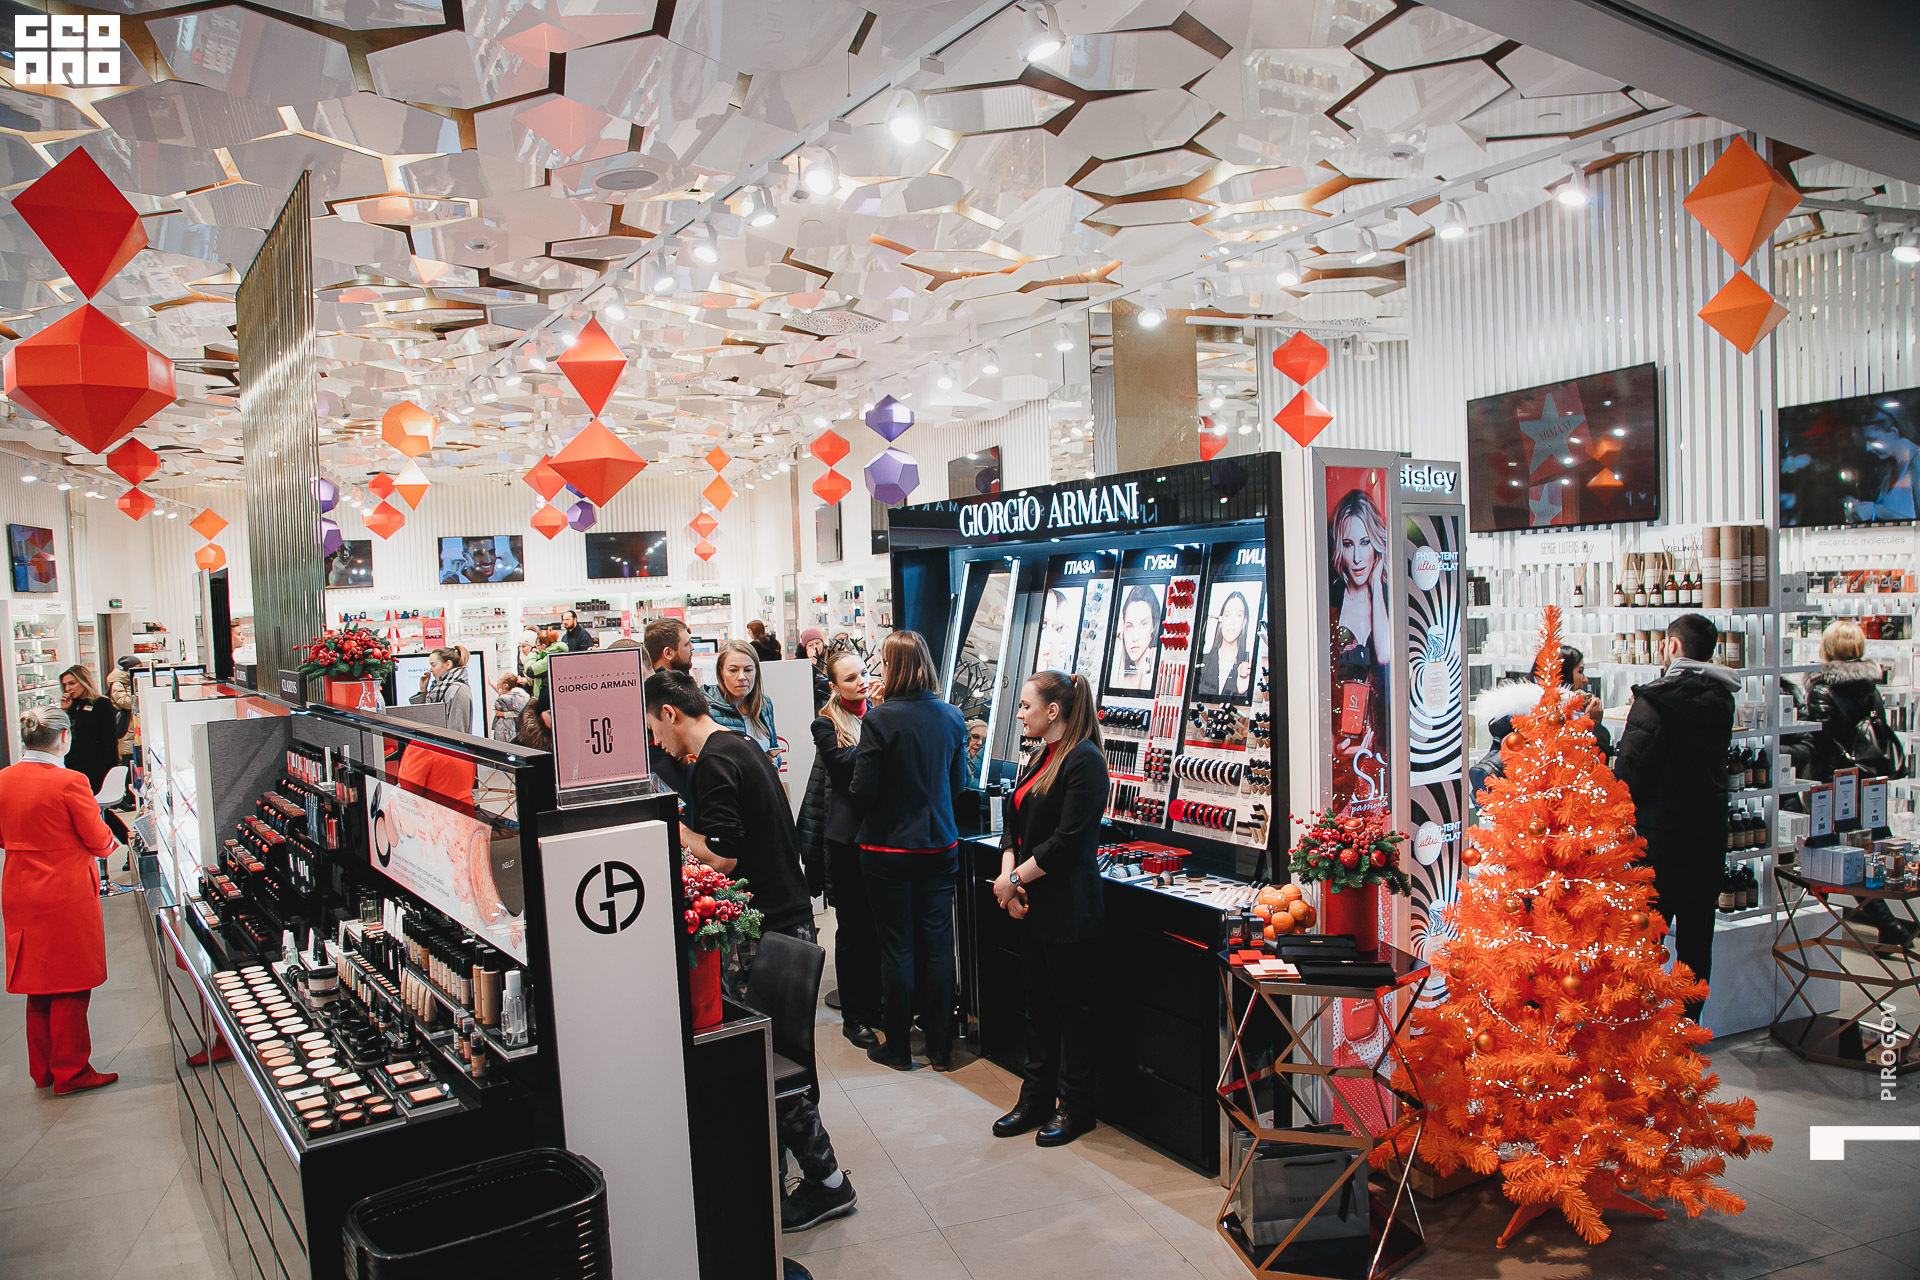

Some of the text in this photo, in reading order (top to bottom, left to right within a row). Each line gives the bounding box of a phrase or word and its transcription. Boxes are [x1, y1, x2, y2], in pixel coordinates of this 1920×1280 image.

[1539, 420, 1572, 441] ARMANI
[1399, 465, 1457, 491] sisley
[959, 496, 1040, 537] GIORGIO
[1047, 482, 1140, 529] ARMANI
[1818, 535, 1905, 546] escentric molecules
[1064, 559, 1096, 575] ГЛАЗА
[1144, 554, 1178, 571] ГУБЫ
[1236, 548, 1266, 567] ЛИЦ
[558, 679, 637, 693] GIORGIO ARMANI
[1352, 748, 1388, 802] Sì
